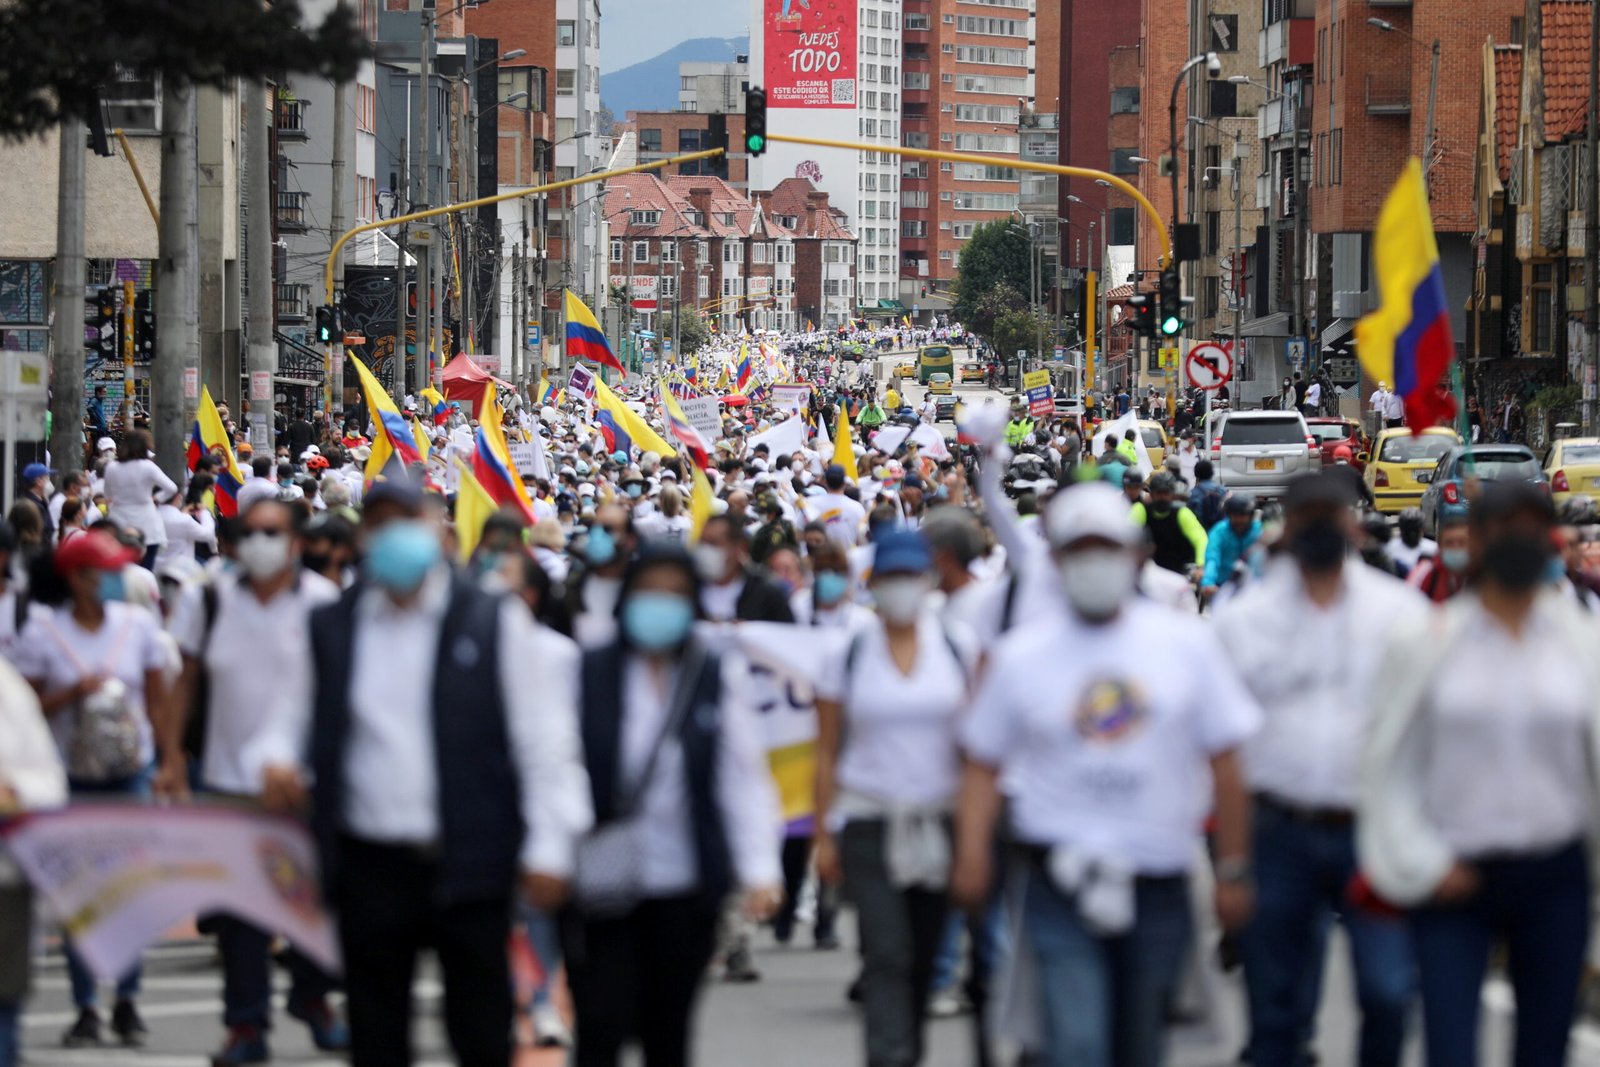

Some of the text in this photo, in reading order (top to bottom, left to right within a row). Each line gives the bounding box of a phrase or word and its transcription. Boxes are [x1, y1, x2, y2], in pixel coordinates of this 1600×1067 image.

[798, 31, 839, 49] PUEDES
[788, 48, 841, 73] TODO
[611, 278, 654, 286] SE ENDE
